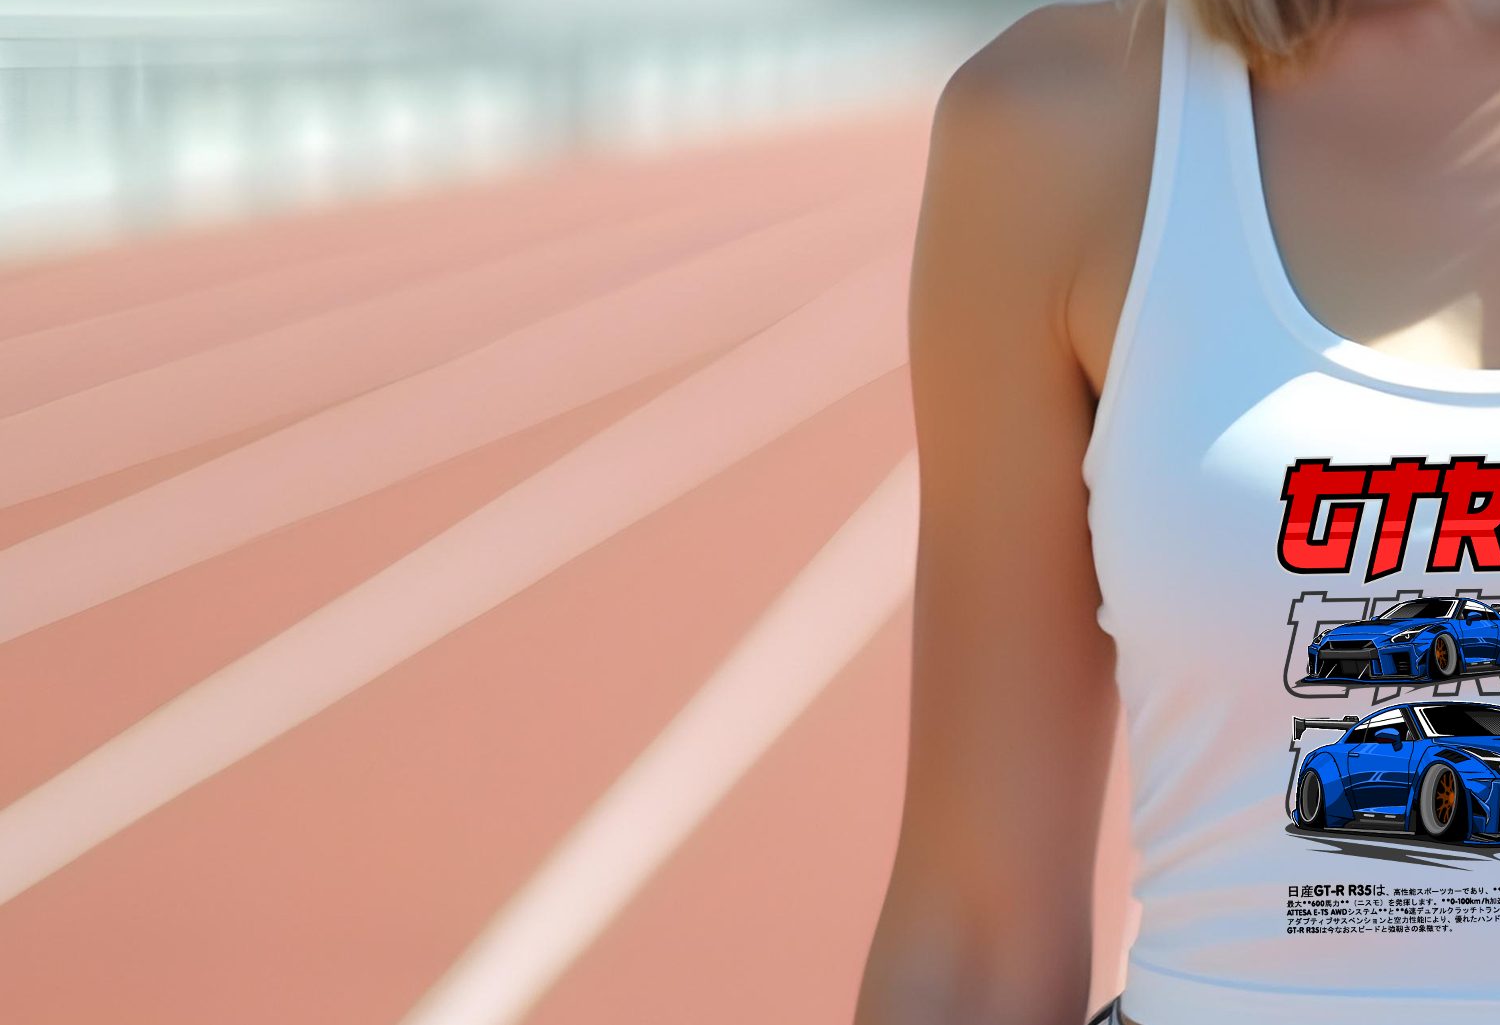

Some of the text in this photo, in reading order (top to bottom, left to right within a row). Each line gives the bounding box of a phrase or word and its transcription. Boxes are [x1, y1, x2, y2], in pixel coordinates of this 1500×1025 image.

[1288, 884, 1345, 898] 日産GT-R
[1287, 909, 1313, 917] ATTESA
[1314, 909, 1329, 917] E-TS
